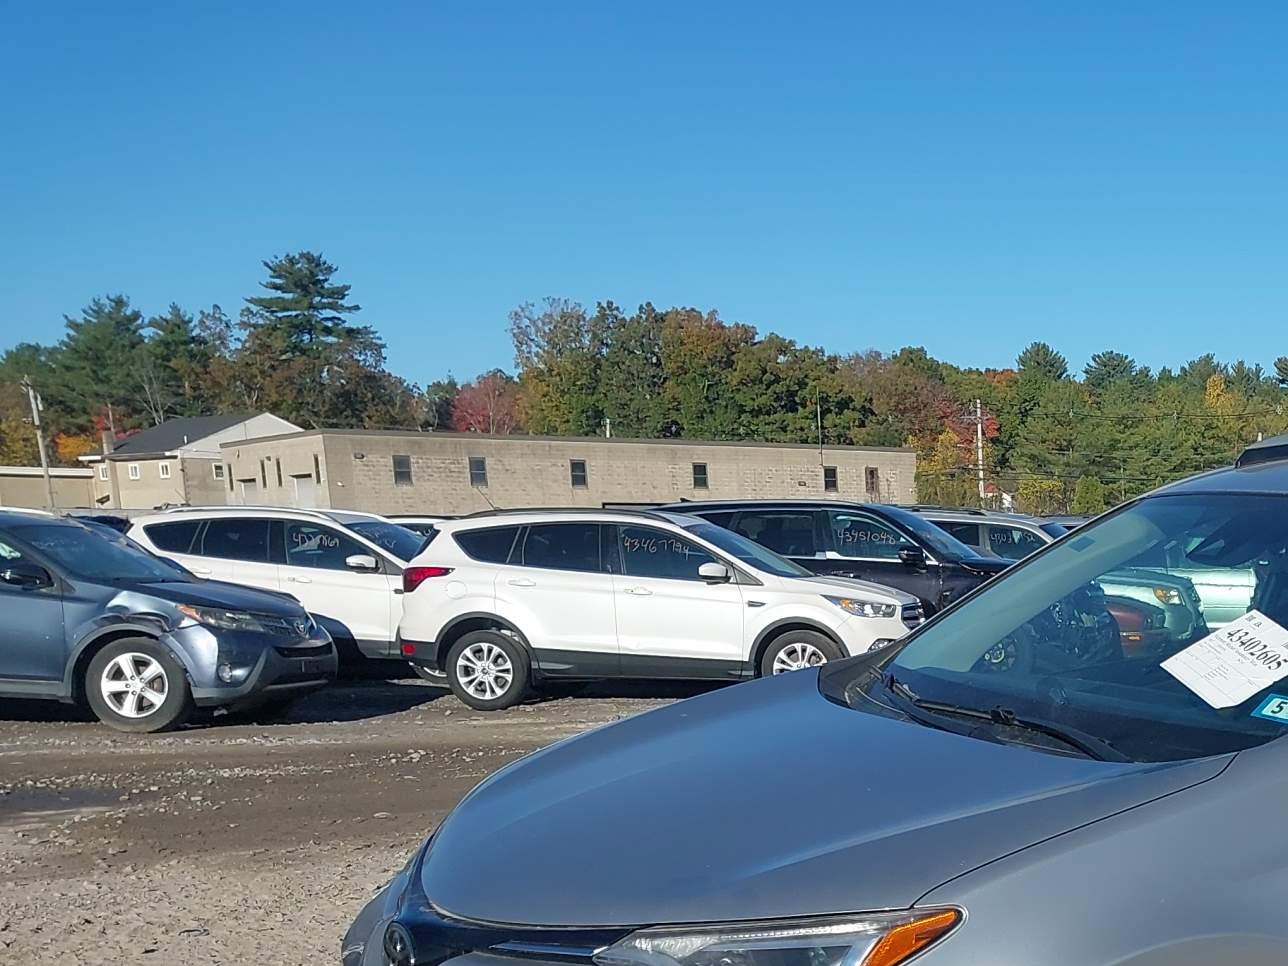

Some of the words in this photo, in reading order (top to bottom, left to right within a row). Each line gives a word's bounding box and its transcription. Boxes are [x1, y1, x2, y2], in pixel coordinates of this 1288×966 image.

[623, 536, 690, 560] 43467794
[1227, 628, 1288, 670] 43402605
[1271, 701, 1288, 714] 5
